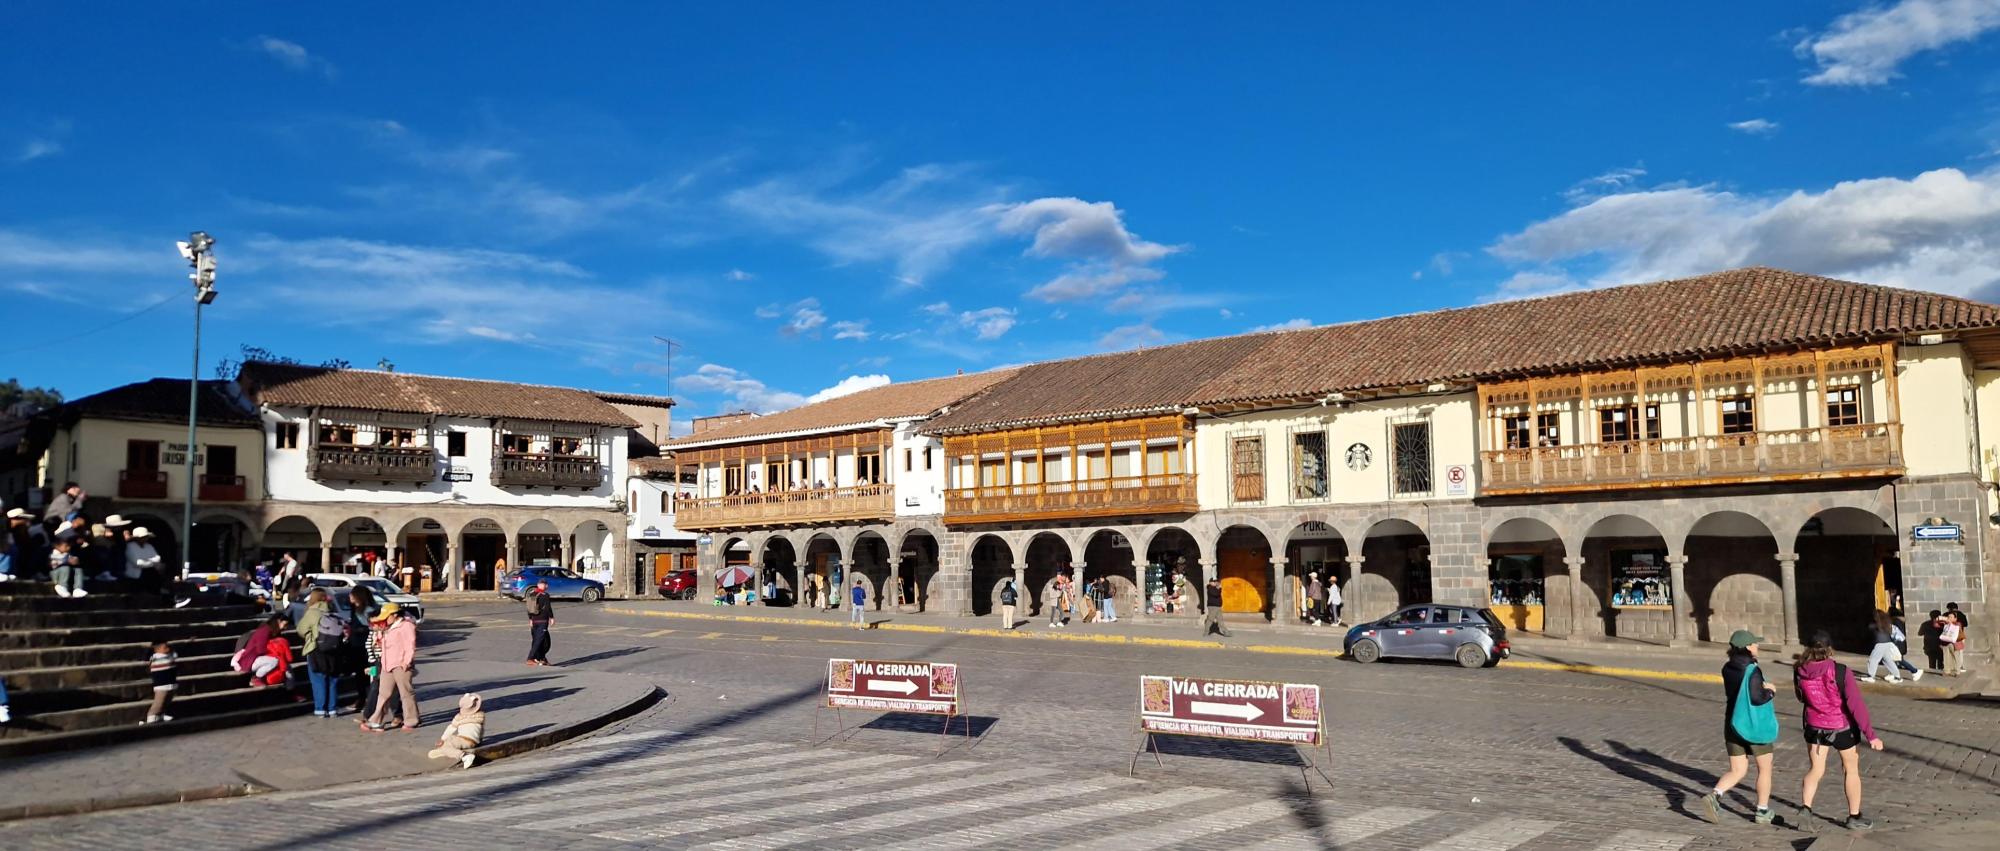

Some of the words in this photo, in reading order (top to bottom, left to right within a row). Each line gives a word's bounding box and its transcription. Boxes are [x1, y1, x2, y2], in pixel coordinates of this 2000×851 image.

[855, 661, 874, 675] VÍA
[876, 663, 930, 677] CERRADA
[1173, 679, 1199, 695] VÍA
[1203, 683, 1279, 699] CERRADA
[1180, 722, 1190, 731] DE
[1224, 726, 1255, 738] VIALIDAD
[1255, 729, 1262, 738] Y
[1262, 729, 1308, 742] TRANSPORTE
